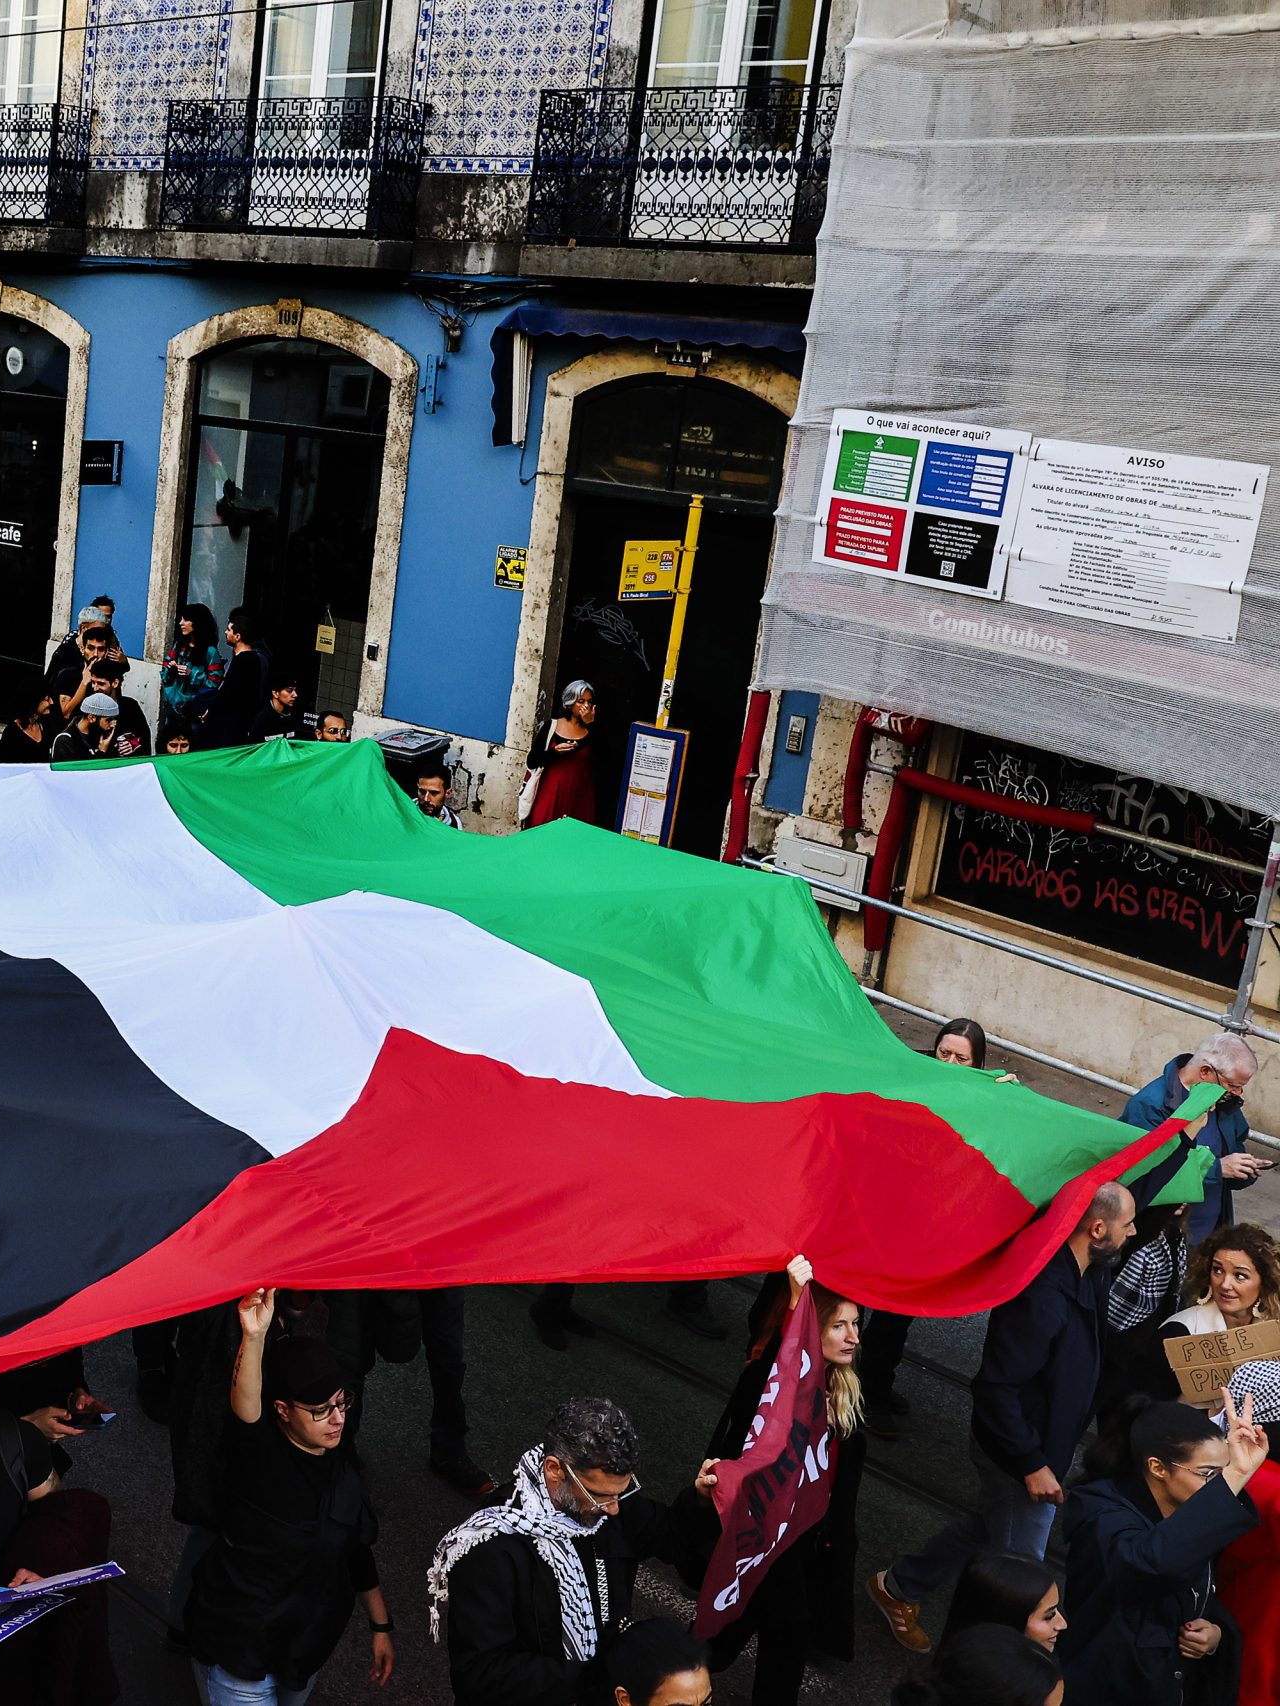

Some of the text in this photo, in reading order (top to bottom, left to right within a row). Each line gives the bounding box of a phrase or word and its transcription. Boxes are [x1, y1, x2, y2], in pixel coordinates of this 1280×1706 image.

[277, 309, 300, 325] 109
[865, 415, 992, 442] O que vai acontecer aqui?
[1126, 456, 1165, 469] AVISO
[928, 608, 1068, 656] Combitubos
[1181, 1328, 1254, 1362] FREE
